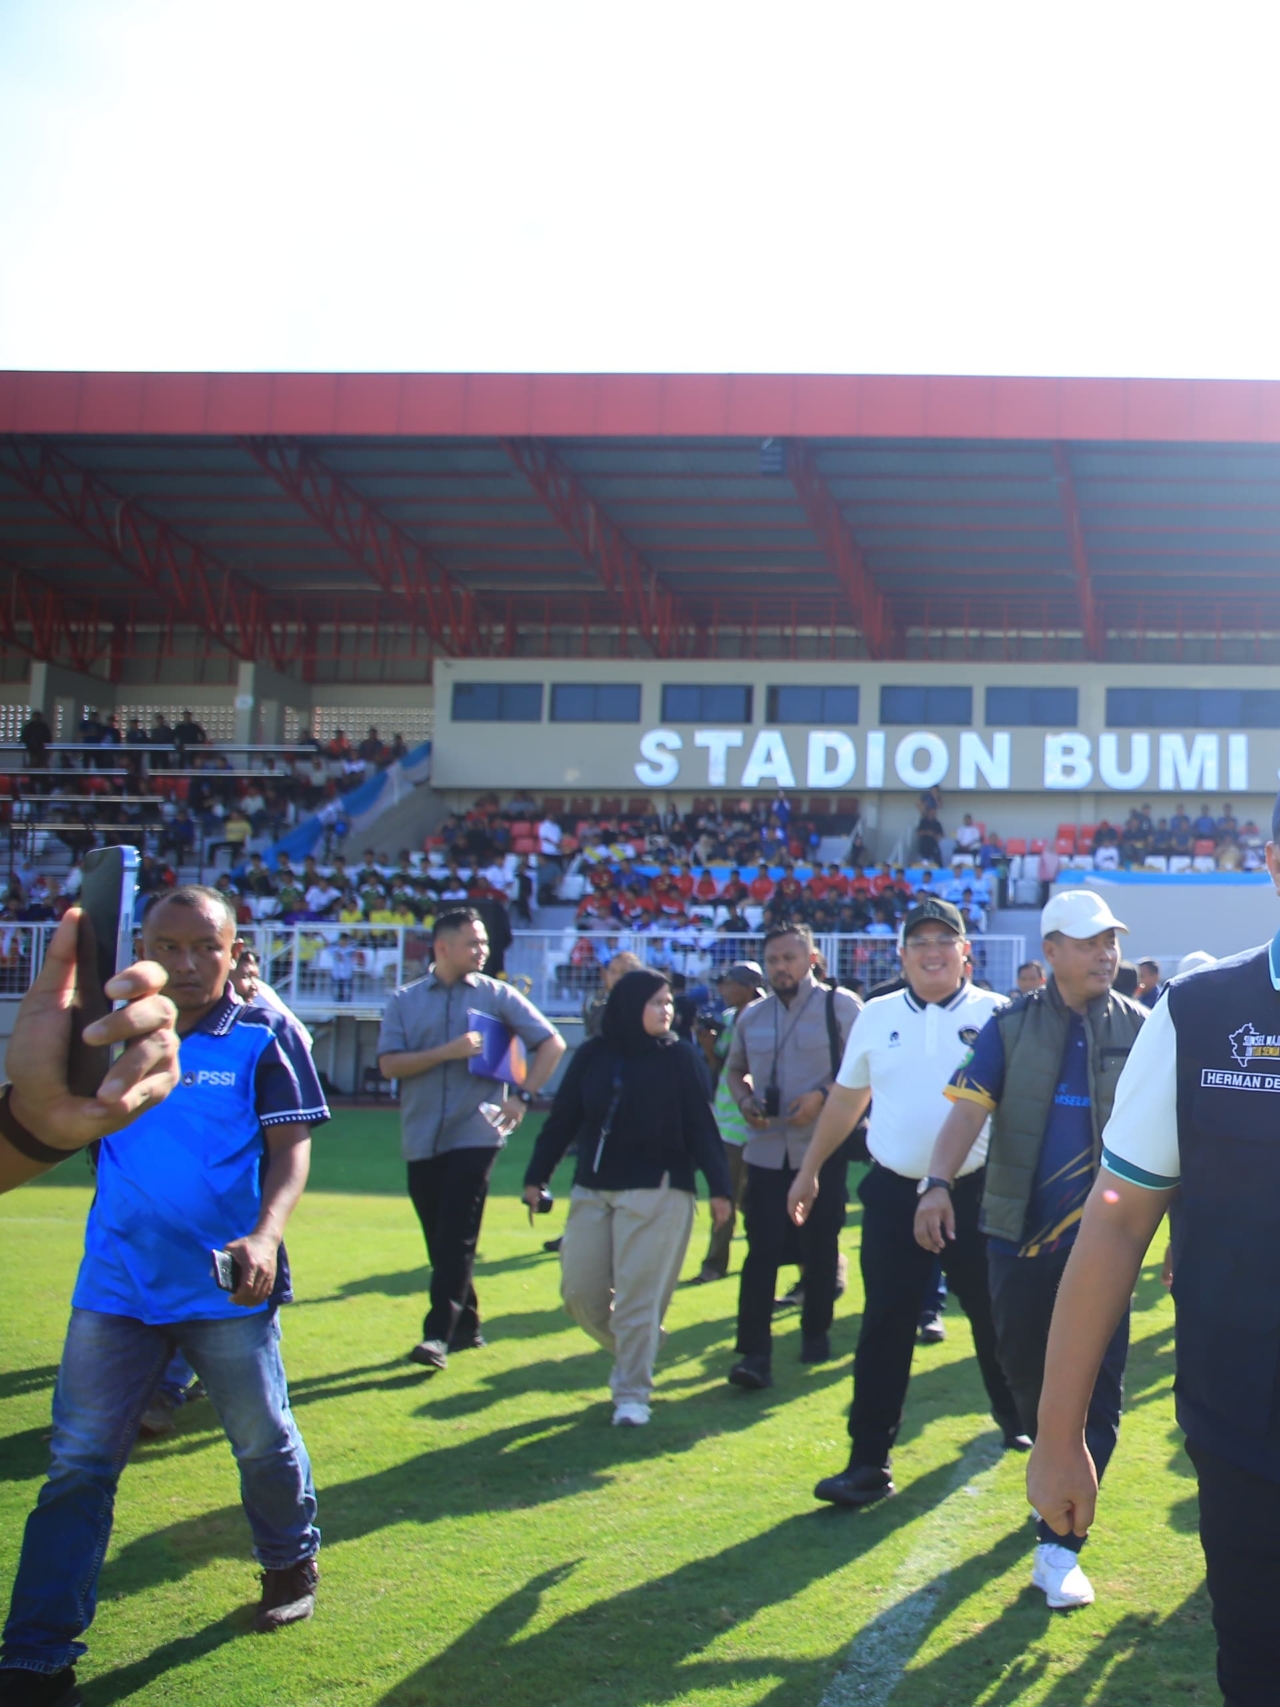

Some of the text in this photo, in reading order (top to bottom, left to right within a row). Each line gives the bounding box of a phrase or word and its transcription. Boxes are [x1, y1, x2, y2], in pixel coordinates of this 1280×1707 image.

[634, 729, 1010, 790] STADION
[1043, 732, 1247, 790] BUMI
[197, 1070, 236, 1086] PSSI
[1207, 1072, 1261, 1088] HERMAN
